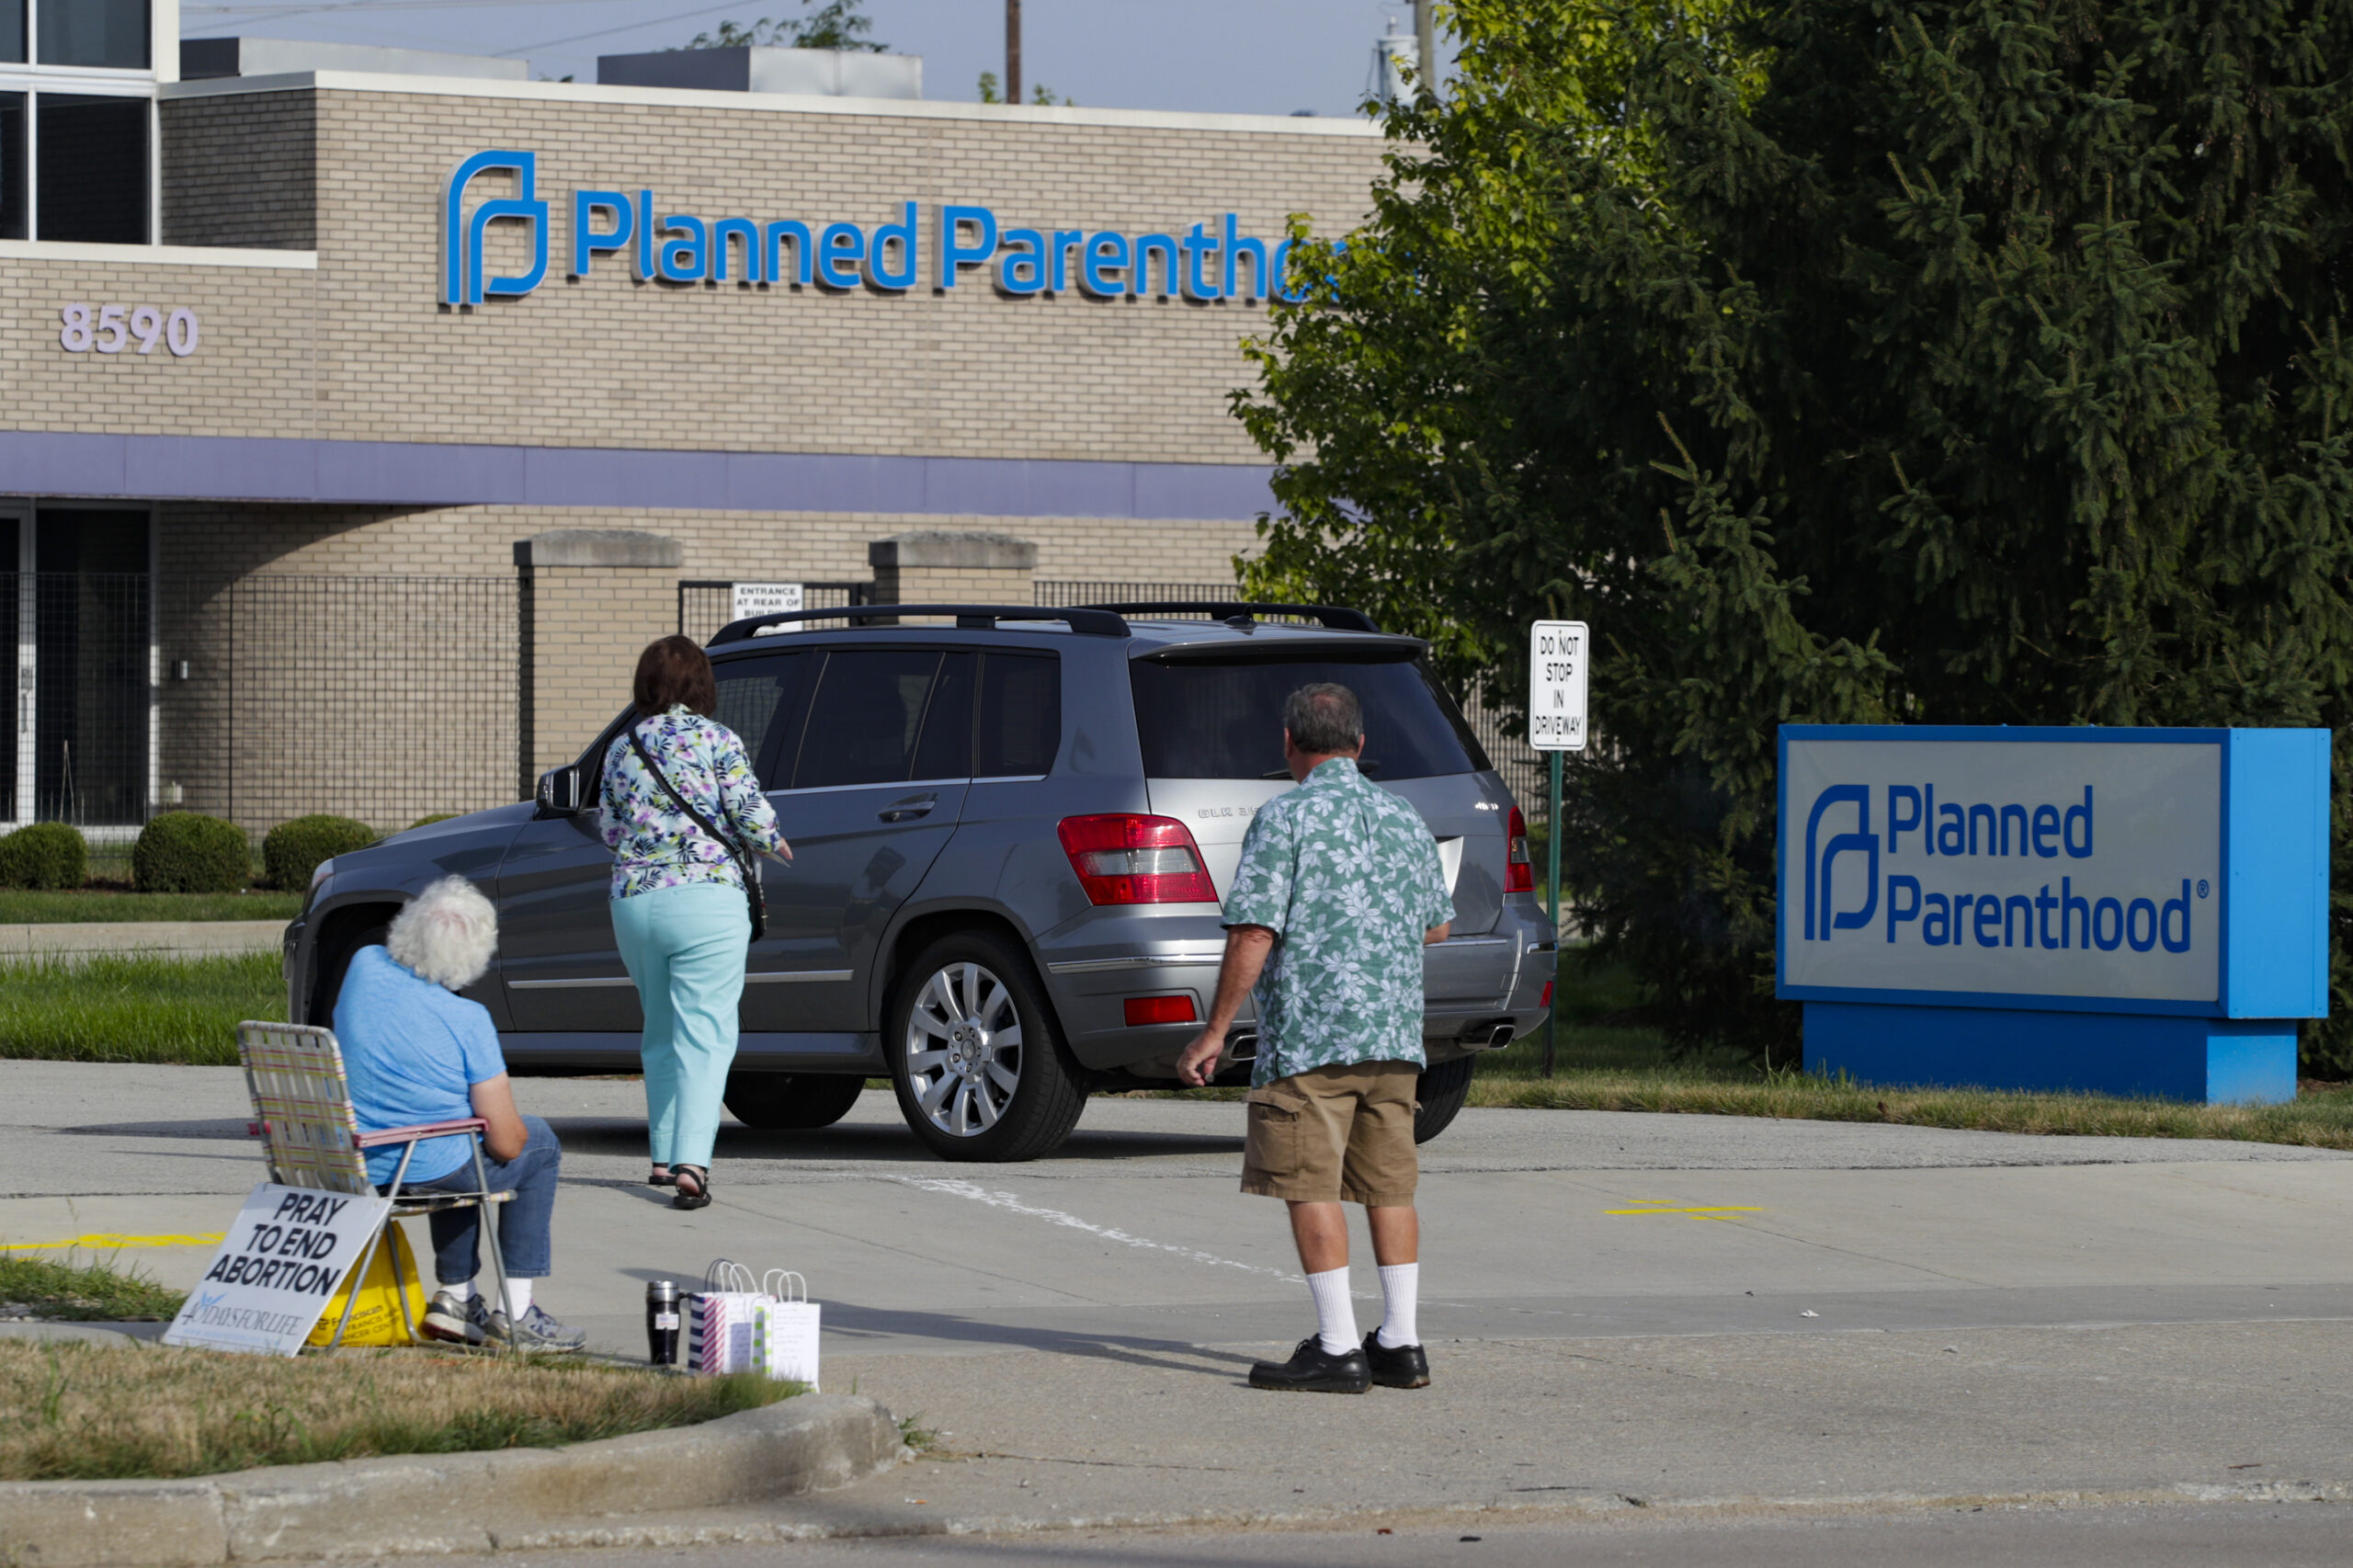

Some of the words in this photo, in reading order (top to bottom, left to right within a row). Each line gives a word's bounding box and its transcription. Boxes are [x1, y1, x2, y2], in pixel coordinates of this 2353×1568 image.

[572, 188, 917, 291] Planned
[938, 206, 1349, 304] Parentho
[60, 301, 199, 358] 8590
[740, 587, 797, 596] ENTRANCE
[736, 597, 749, 607] AT
[754, 597, 782, 607] REAR
[786, 597, 801, 607] OF
[744, 608, 791, 618] BUILDI
[1540, 636, 1554, 655] DO
[1559, 636, 1579, 655] NOT
[1545, 662, 1574, 682] STOP
[1553, 689, 1564, 709] IN
[1535, 715, 1582, 735] DRIVEWAY
[1198, 808, 1233, 818] GLK
[1888, 783, 2094, 859] Planned
[274, 1193, 349, 1226] PRAY
[246, 1223, 282, 1254] TO
[278, 1228, 336, 1260] END
[205, 1254, 341, 1296] ABORTION
